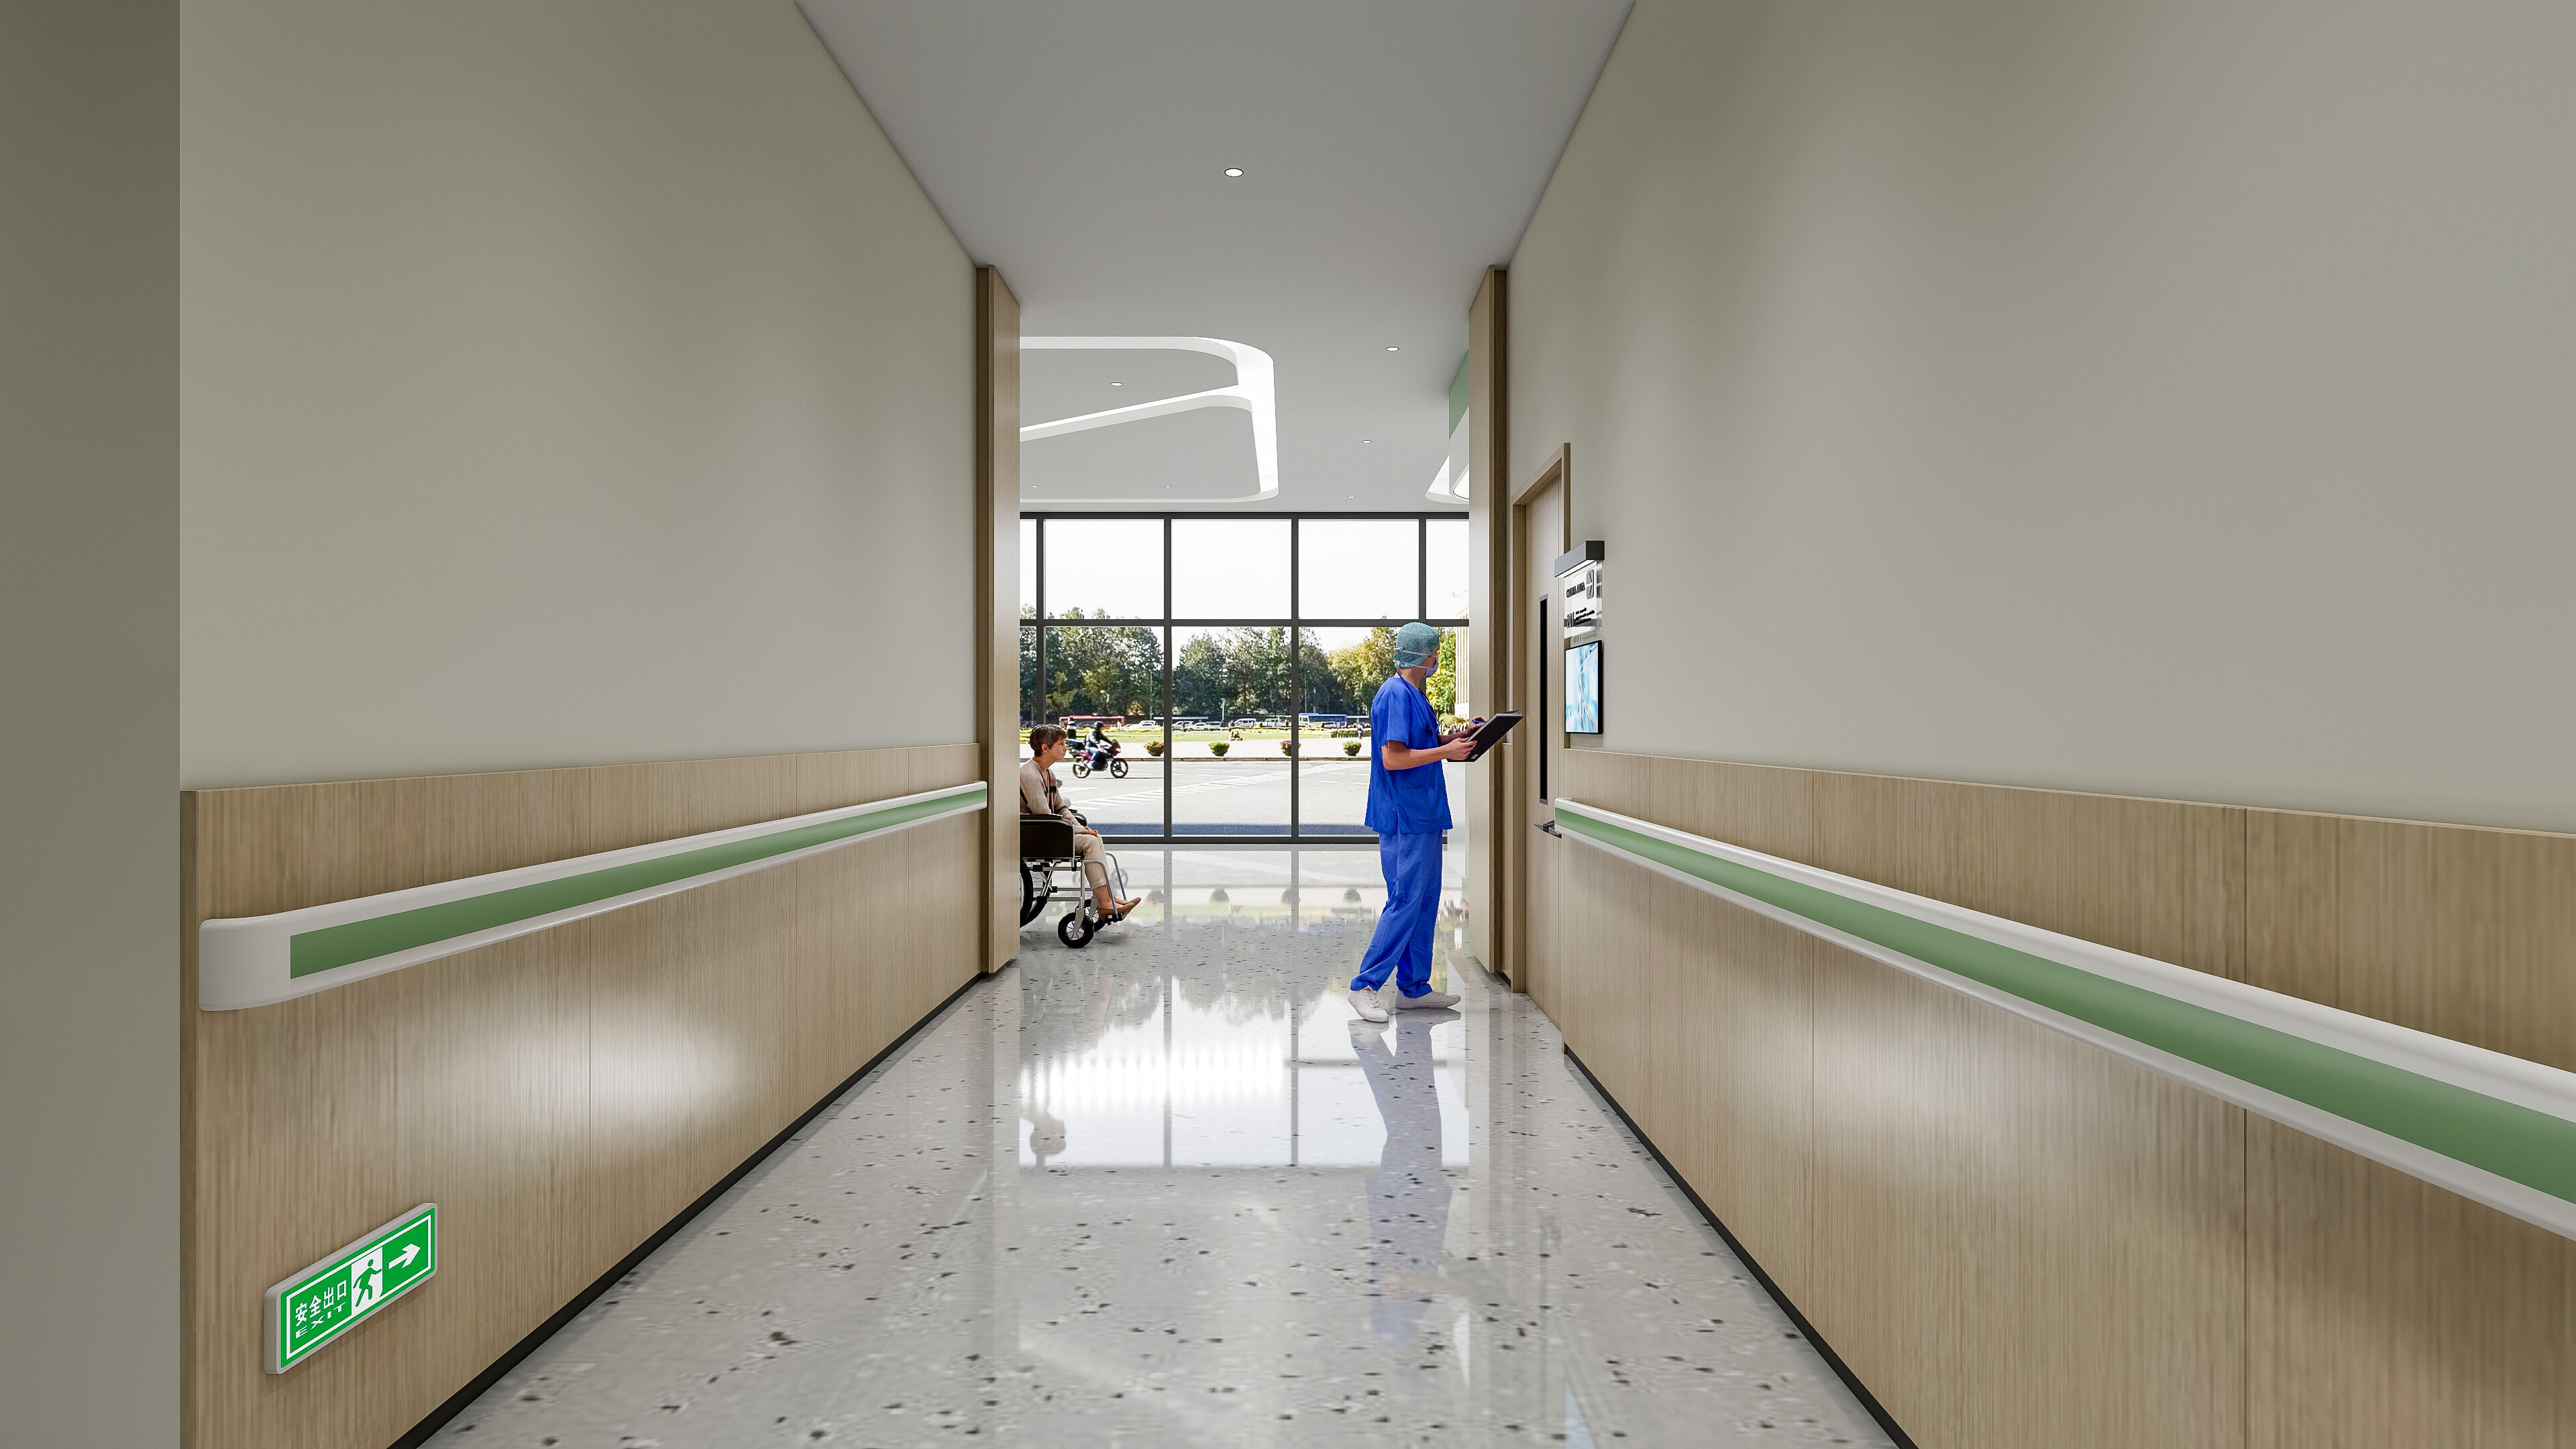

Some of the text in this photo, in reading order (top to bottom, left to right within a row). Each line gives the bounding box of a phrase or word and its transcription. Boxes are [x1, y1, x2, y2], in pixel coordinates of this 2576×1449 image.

[295, 1280, 346, 1327] 安全出口
[296, 1301, 346, 1339] EXIT
